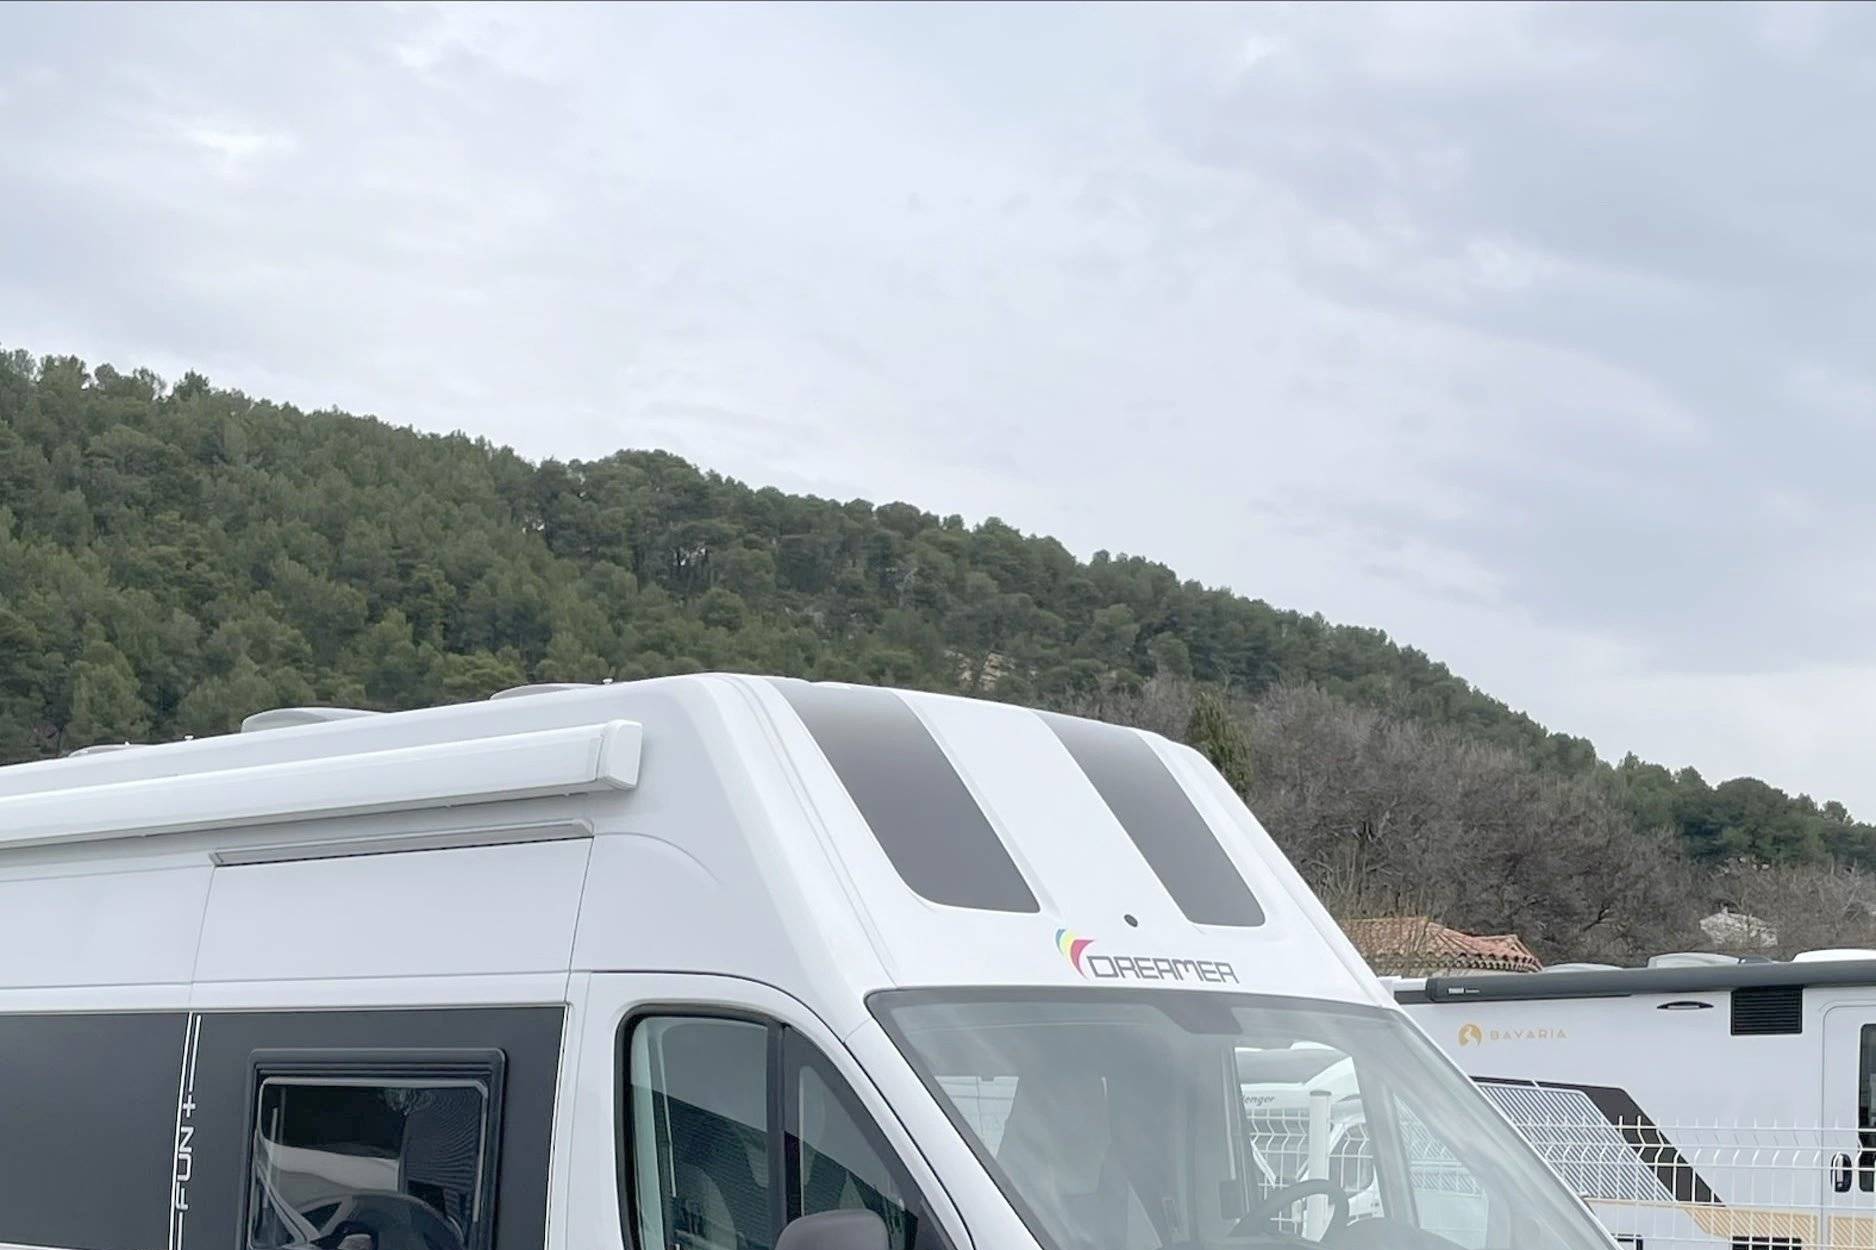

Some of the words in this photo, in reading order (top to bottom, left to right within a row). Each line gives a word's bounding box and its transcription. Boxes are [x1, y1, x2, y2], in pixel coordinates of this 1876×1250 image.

[1086, 955, 1240, 984] DREAMER
[1489, 1029, 1568, 1041] BAVARIA
[175, 1126, 195, 1211] FUN
